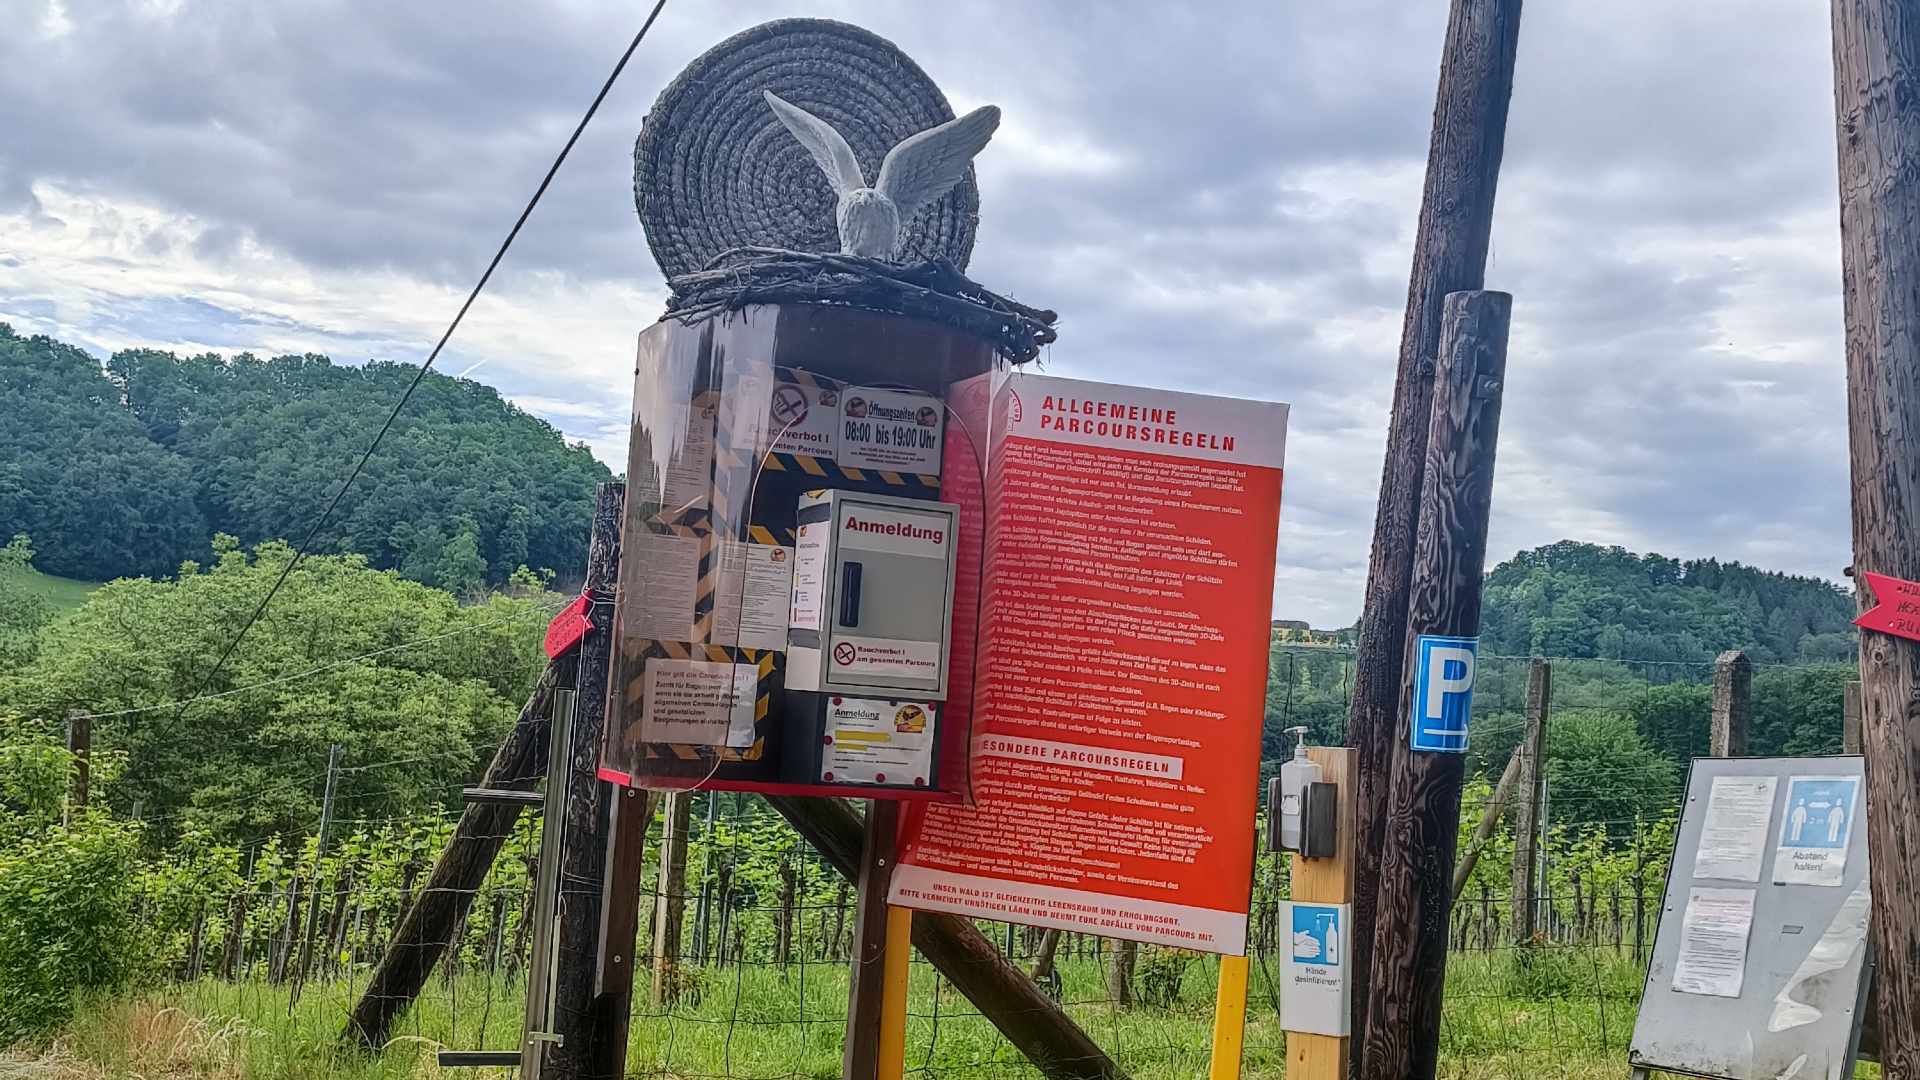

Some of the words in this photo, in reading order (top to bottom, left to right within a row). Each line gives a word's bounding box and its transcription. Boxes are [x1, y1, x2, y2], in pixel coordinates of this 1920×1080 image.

[867, 401, 915, 421] Öffnungszeiten
[1040, 395, 1177, 424] ALLGEMEINE
[844, 421, 871, 443] 08:00
[875, 425, 890, 446] bis
[891, 426, 917, 448] 19:00
[919, 429, 936, 450] Uhr
[1039, 414, 1235, 451] PARCOURSREGELN
[797, 444, 833, 456] Parcours
[845, 517, 943, 544] Anmeldung
[869, 657, 903, 666] gesamten
[905, 660, 935, 668] Parcours
[1427, 647, 1474, 718] P
[834, 709, 880, 720] Anmeldung
[982, 739, 1047, 757] ESONDERE
[1053, 748, 1169, 773] PARCOURSREGELN
[1792, 851, 1828, 860] Abstand
[932, 883, 955, 893] UNSER
[959, 887, 980, 896] WALD
[981, 890, 993, 898] IST
[1048, 900, 1098, 913] LEBENSRAUM
[1100, 907, 1116, 916] UND
[899, 888, 919, 898] BITTE
[921, 891, 962, 904] VERMEIDET
[1008, 904, 1030, 914] LÄRM
[1032, 908, 1047, 917] UND
[1050, 910, 1076, 921] NEHMT
[1078, 914, 1098, 924] EURE
[1135, 923, 1152, 932] VOM
[1155, 926, 1195, 938] PARCOURS
[1198, 932, 1214, 941] MIT.
